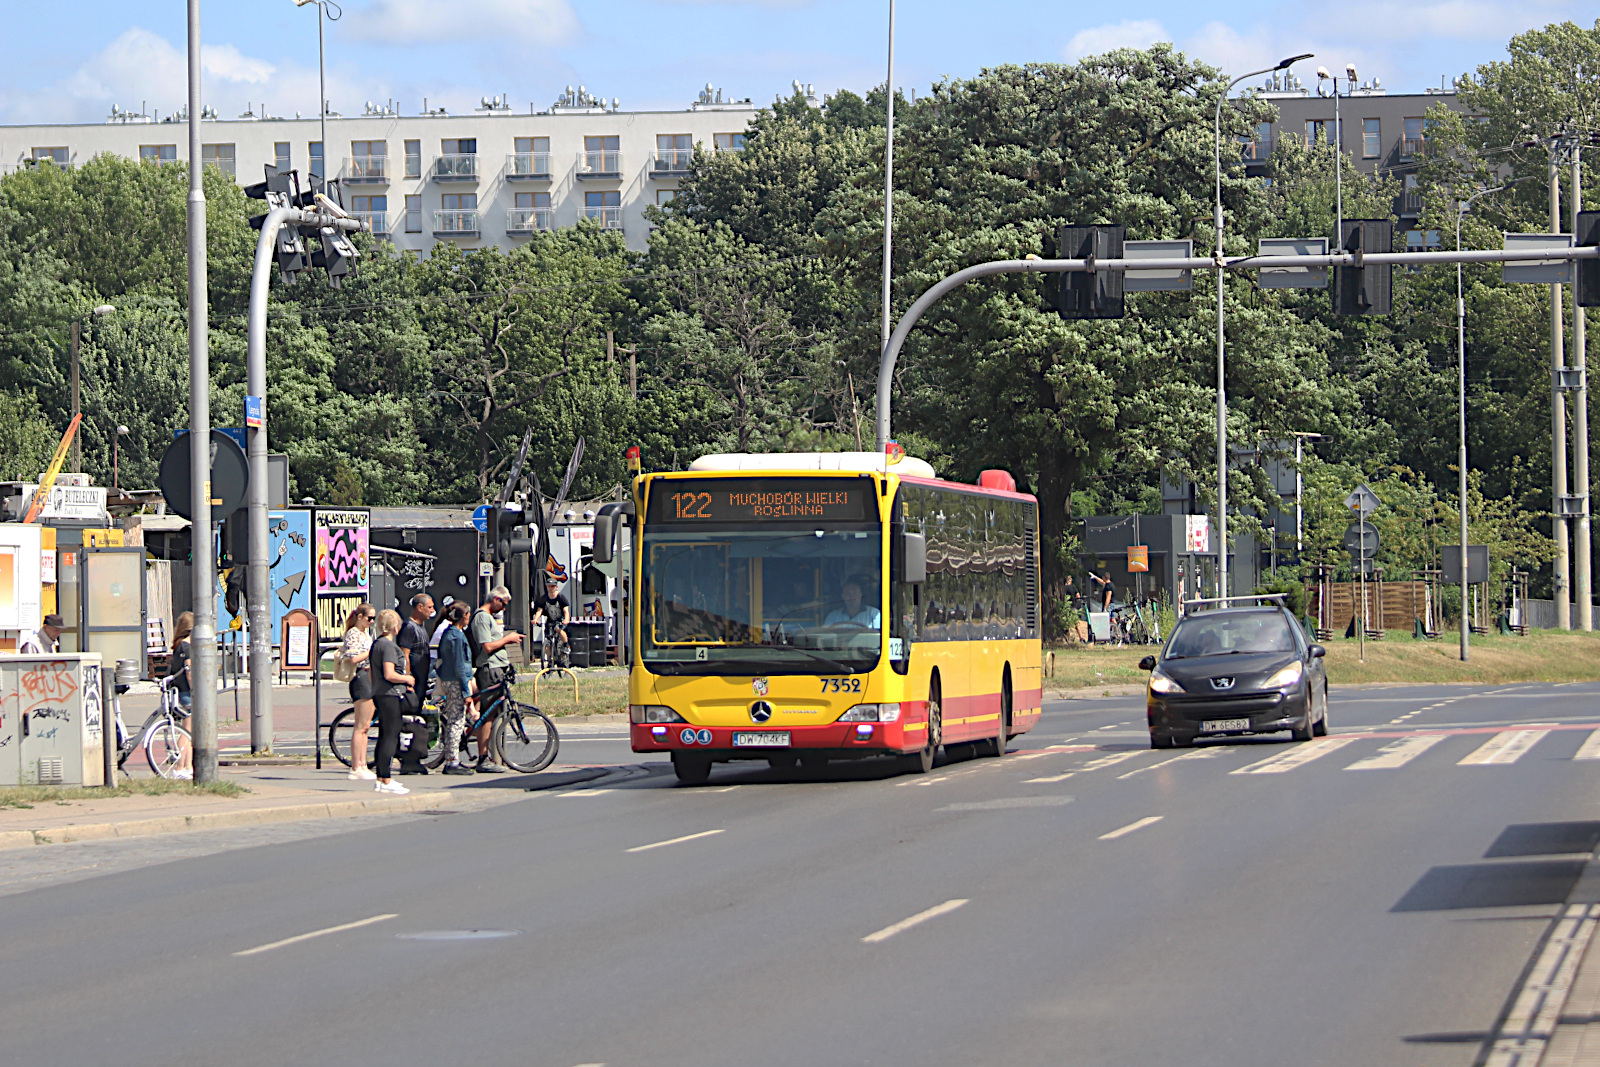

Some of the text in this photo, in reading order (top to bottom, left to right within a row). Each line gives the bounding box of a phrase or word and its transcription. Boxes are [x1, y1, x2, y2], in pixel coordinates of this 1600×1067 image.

[671, 492, 712, 518] 122
[729, 491, 848, 505] MUCHOBÓR WIELKI
[698, 649, 705, 660] 4
[889, 642, 903, 656] 122
[820, 678, 861, 693] 7352
[1204, 721, 1217, 731] DW
[739, 734, 755, 745] DW
